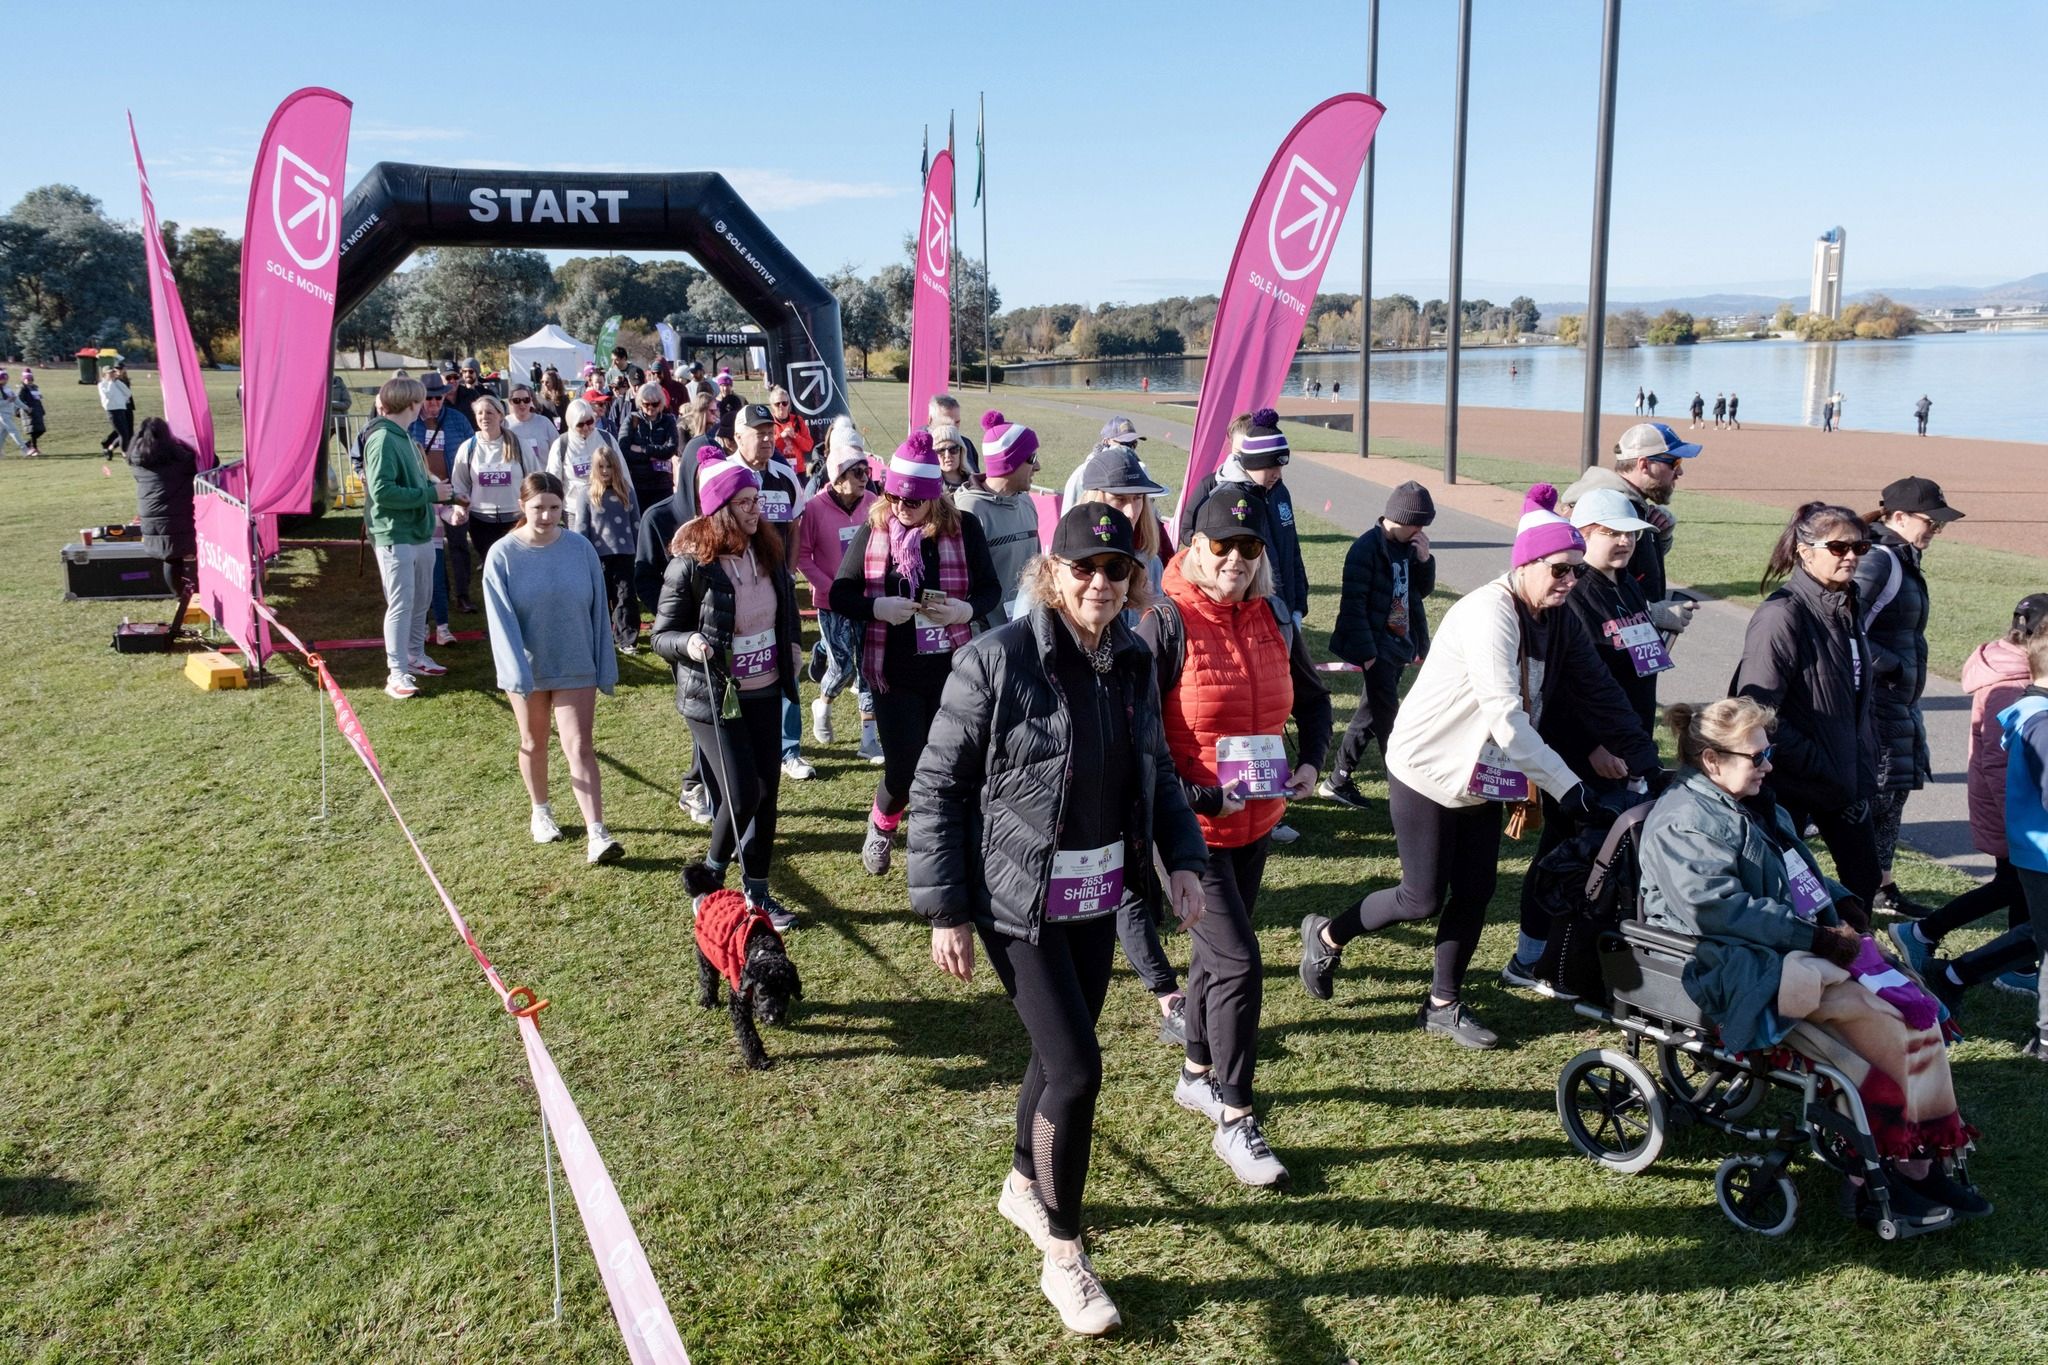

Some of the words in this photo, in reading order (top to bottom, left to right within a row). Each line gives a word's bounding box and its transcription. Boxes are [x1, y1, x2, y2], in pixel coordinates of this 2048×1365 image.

[469, 187, 629, 224] START
[346, 213, 380, 246] MOTIVE
[725, 232, 748, 255] SOLE
[744, 252, 777, 286] MOTIVE
[266, 259, 295, 283] SOLE
[296, 275, 334, 305] MOTIVE
[1248, 271, 1273, 294] SOLE
[1271, 285, 1307, 316] MOTIVE
[706, 333, 748, 345] FINISH
[810, 417, 834, 426] MOTIV
[483, 471, 507, 480] 2730
[736, 648, 772, 668] 2748
[1634, 642, 1662, 661] 2725
[1247, 760, 1270, 769] 2680
[1238, 768, 1278, 781] HELEN
[1475, 772, 1517, 787] CHRISTINE
[1255, 783, 1267, 791] 5K
[1081, 875, 1104, 888] 2653
[1063, 881, 1114, 901] SHIRLEY
[1083, 901, 1095, 910] 5K
